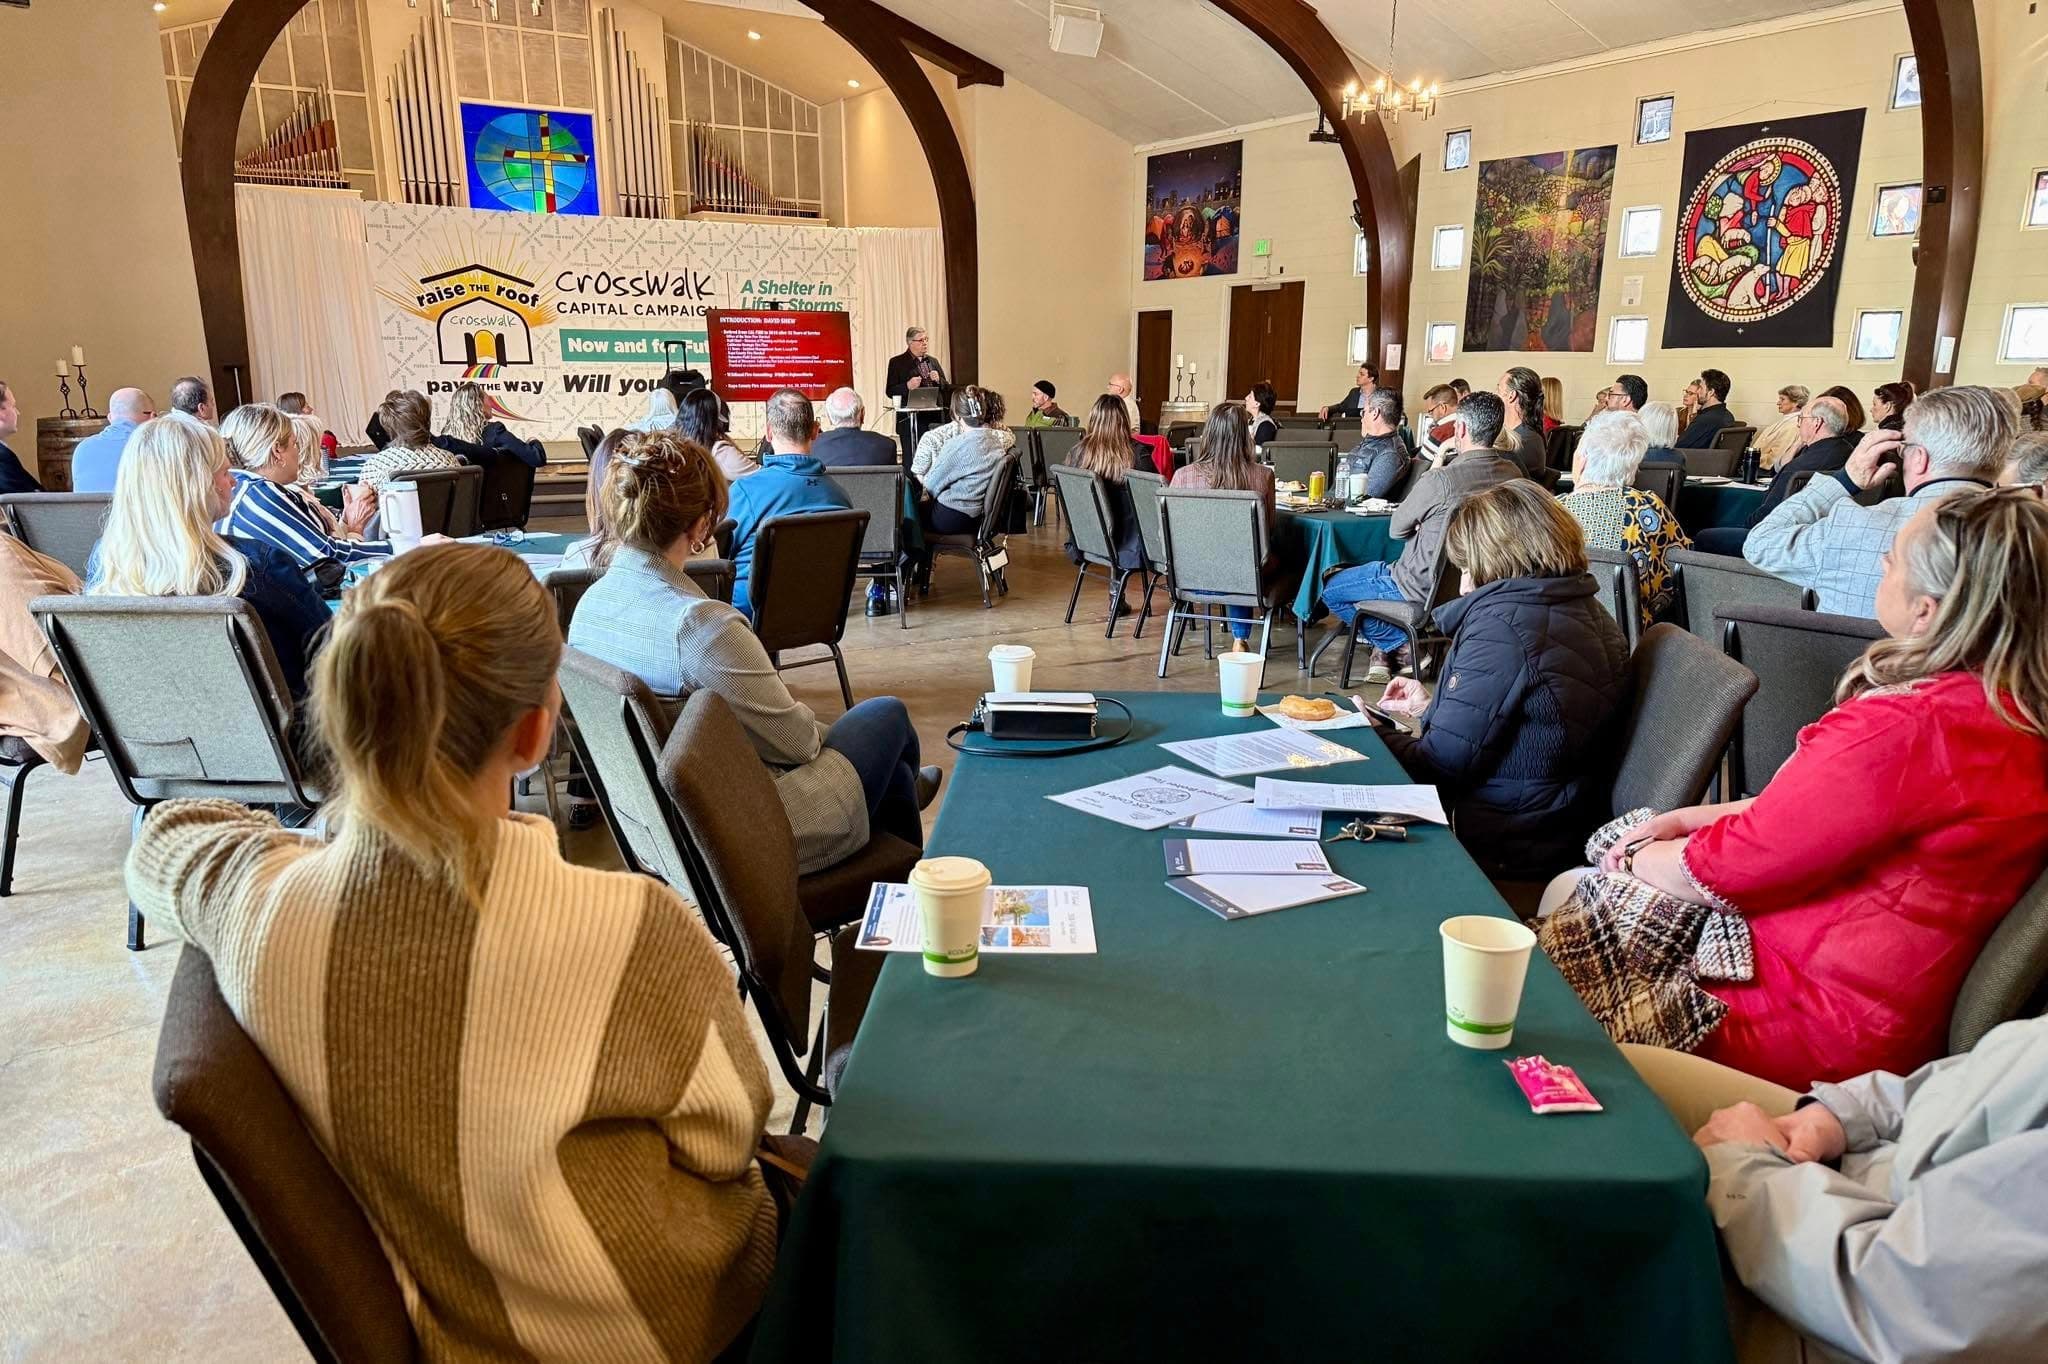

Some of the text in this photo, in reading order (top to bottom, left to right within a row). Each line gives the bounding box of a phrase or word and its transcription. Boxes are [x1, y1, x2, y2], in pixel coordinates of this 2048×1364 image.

[740, 279, 833, 295] A Shelter in
[416, 284, 540, 307] raise THE roof
[557, 302, 716, 316] CAPITAL CAMPAIG
[788, 298, 843, 311] Storms
[568, 338, 609, 353] Now
[614, 339, 648, 353] and
[652, 339, 678, 353] for
[480, 383, 501, 391] THE
[503, 381, 544, 394] way
[563, 374, 612, 393] Will
